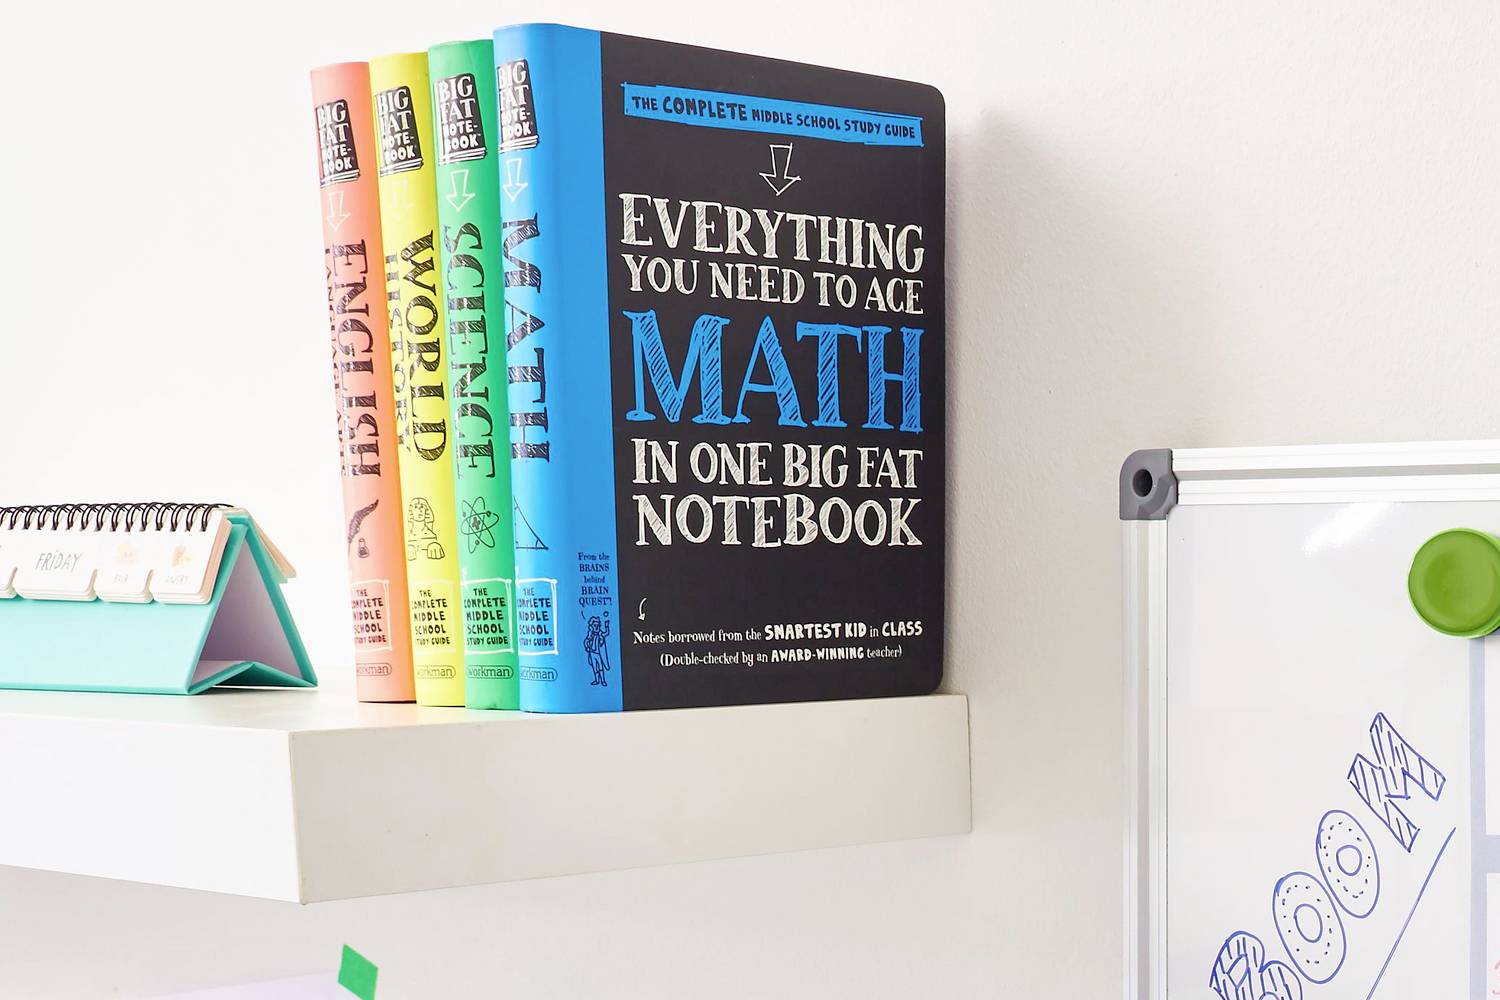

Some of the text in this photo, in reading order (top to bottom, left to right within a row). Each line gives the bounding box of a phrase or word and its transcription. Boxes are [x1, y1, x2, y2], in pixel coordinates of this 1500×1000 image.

[438, 76, 473, 100] BIG
[440, 98, 476, 124] FAT
[632, 95, 916, 139] THE COMPLETE MIDDLE SCHOOL STUDY GUIDE
[618, 192, 926, 274] EVERYTHING
[621, 254, 925, 315] YOU NEED TO ACE
[399, 229, 447, 462] WORLD
[502, 211, 551, 464] MATH
[331, 238, 381, 478] ENGLISH
[441, 222, 497, 479] SCIENCE
[622, 309, 926, 434] MATH
[631, 438, 923, 489] IN ONE BIG FAT
[632, 493, 923, 549] NOTEBOOK
[579, 563, 610, 573] BRAINS
[419, 589, 432, 598] THE
[473, 588, 489, 597] THE
[581, 585, 609, 596] BRAIN
[463, 598, 507, 609] COMPLETE
[466, 610, 504, 621] MIDDLE
[368, 634, 387, 644] GUIDE
[467, 623, 505, 635] SCHOOL
[486, 636, 509, 646] GUIDE
[633, 620, 924, 645] Notes borrowed from the SMARTEST KID in CLASS
[431, 637, 452, 646] GUIDE
[533, 638, 554, 647] GUIDE
[659, 644, 903, 667] (Double-checked by an AWARD-WINNING teacher)
